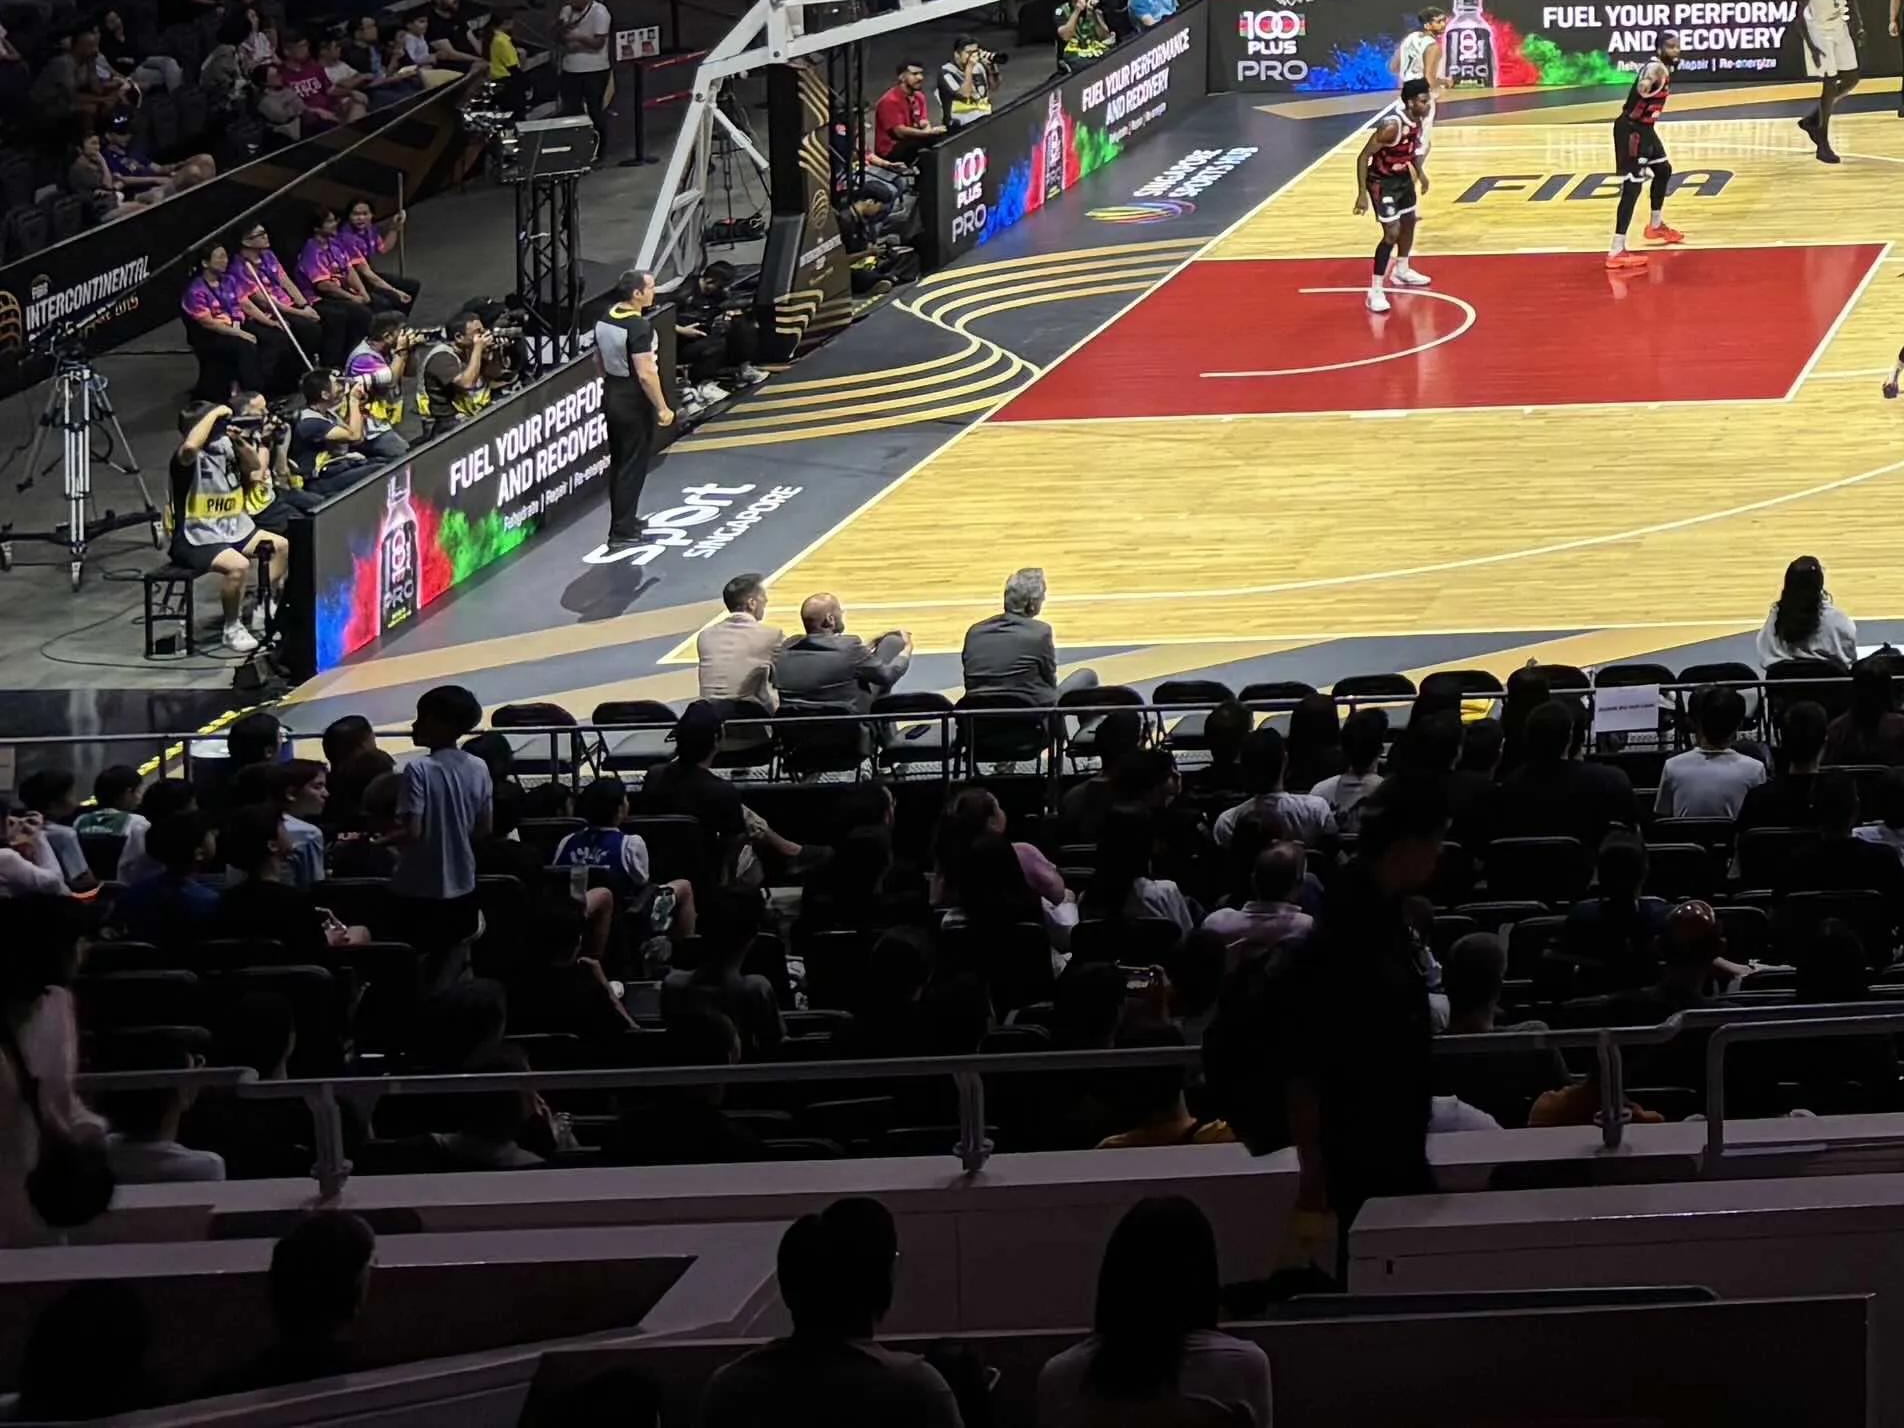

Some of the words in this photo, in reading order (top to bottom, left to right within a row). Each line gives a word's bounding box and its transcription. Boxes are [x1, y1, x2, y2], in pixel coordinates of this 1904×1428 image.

[1240, 10, 1306, 41] 100
[1543, 6, 1602, 29] FUEL
[1605, 4, 1670, 26] YOUR
[1248, 40, 1297, 55] PLUS
[1608, 30, 1657, 53] AND
[1082, 79, 1105, 112] FUEL
[1105, 64, 1130, 97] YOUR
[1130, 27, 1190, 83] PERFORMANCE
[1237, 59, 1308, 81] PRO
[1106, 95, 1126, 126] AND
[1126, 66, 1170, 114] RECOVERY
[953, 147, 988, 191] 100
[957, 184, 982, 209] PLUS
[952, 206, 988, 243] PRO
[25, 254, 151, 333] INTERCONTINENTAL
[450, 441, 494, 496] FUEL
[496, 417, 544, 466] YOUR
[497, 462, 534, 508] AND
[682, 485, 804, 559] SINGAPORE
[383, 578, 415, 611] PRO
